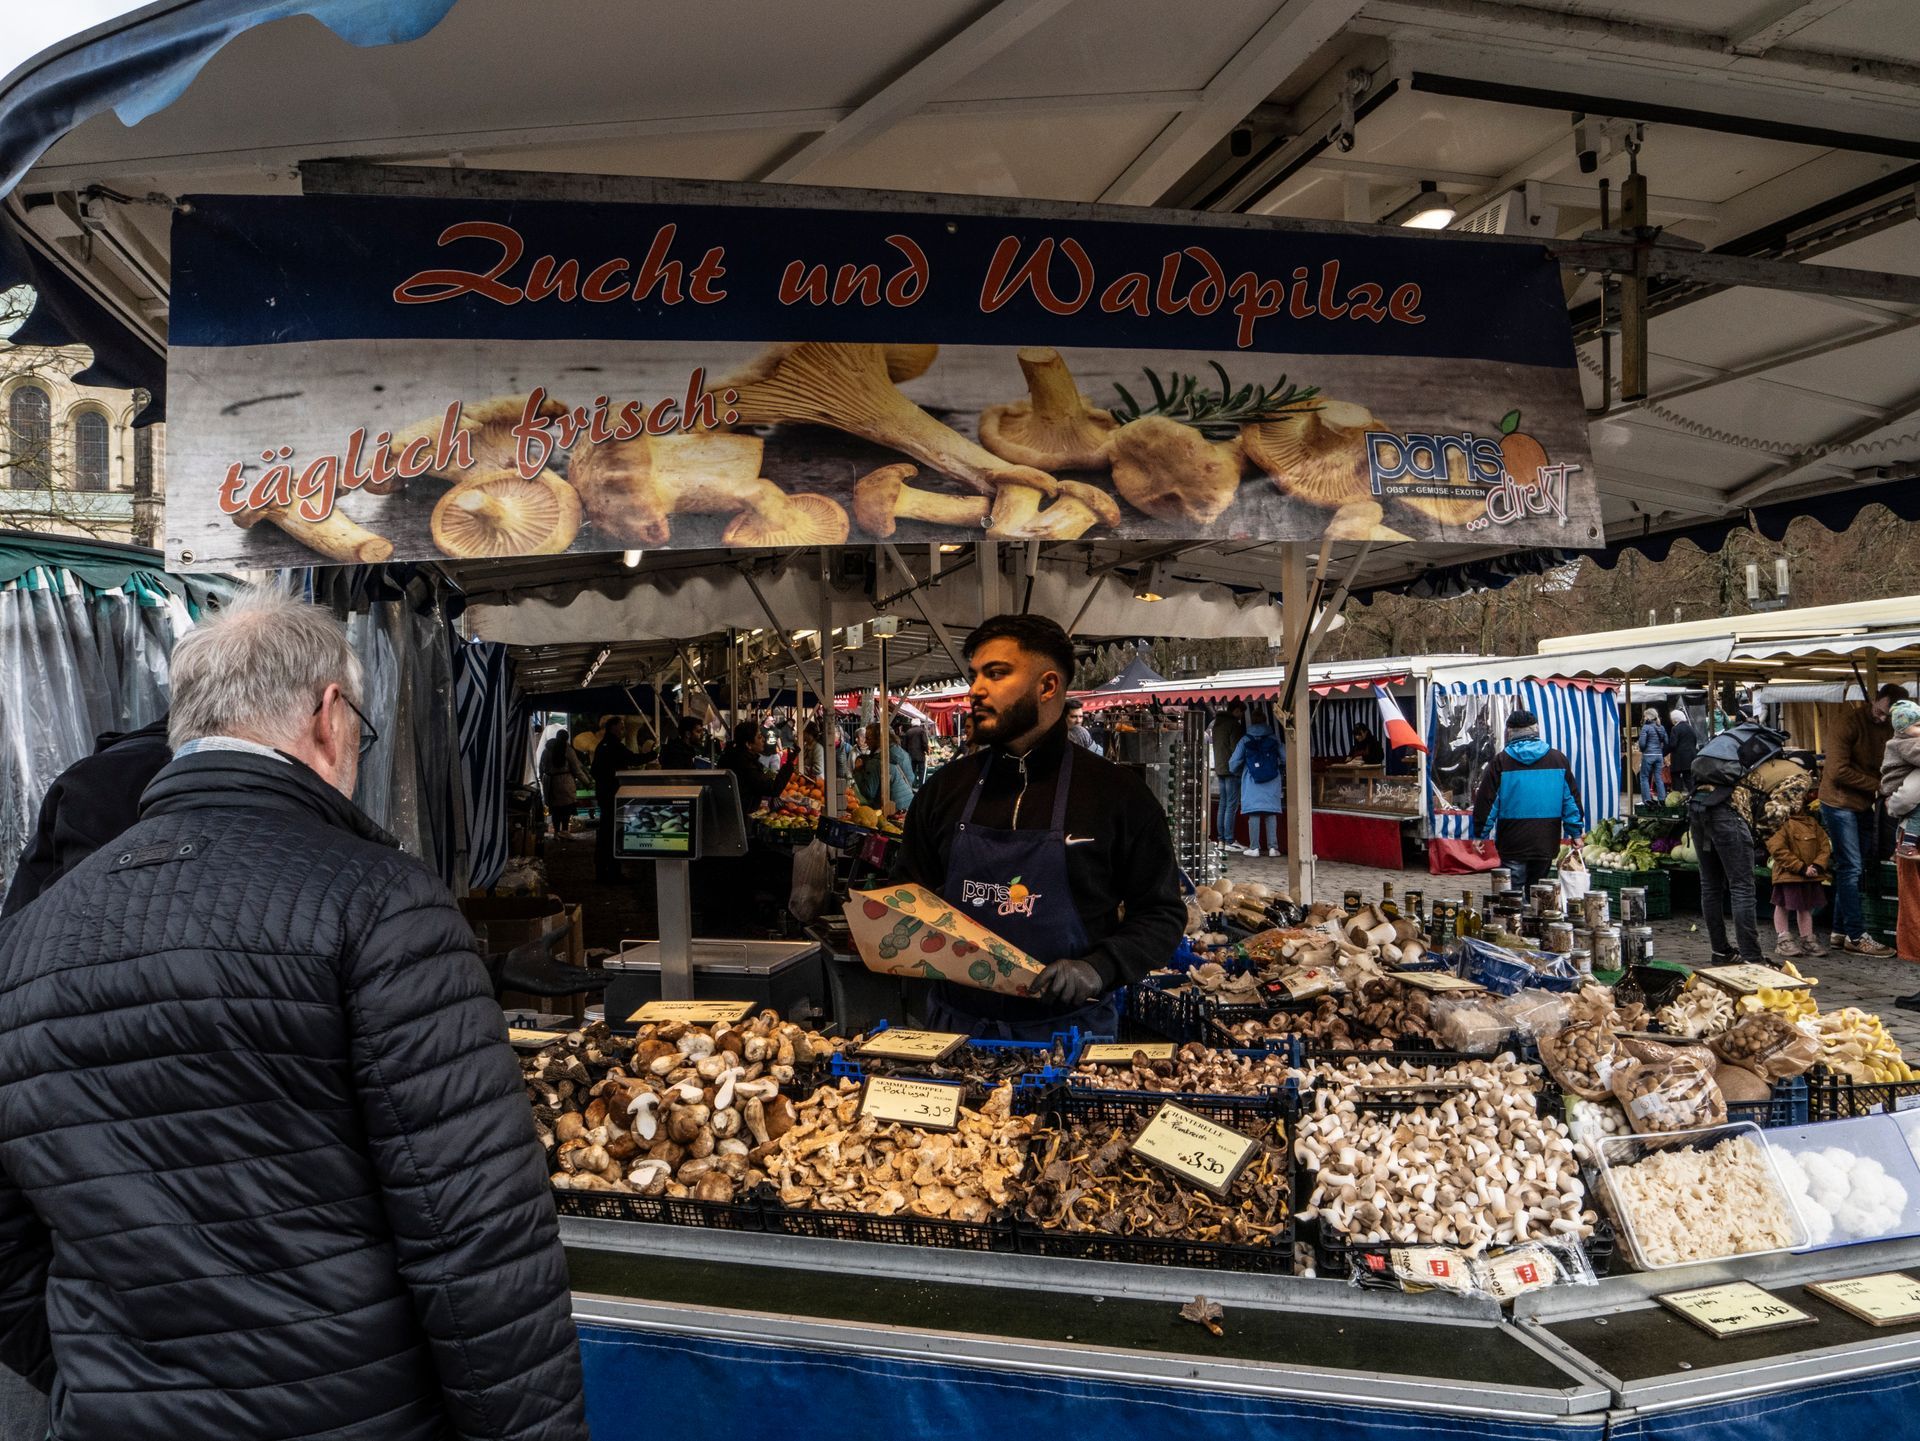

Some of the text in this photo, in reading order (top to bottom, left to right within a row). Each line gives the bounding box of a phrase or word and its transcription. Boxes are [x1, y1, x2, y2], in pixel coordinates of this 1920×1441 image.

[394, 221, 1426, 348] Zucht und Waldpilze
[216, 366, 740, 522] täglich frisch:
[1364, 431, 1506, 495] paris
[1386, 486, 1409, 494] OBST
[1455, 488, 1486, 497] EXOTEN
[876, 1080, 944, 1094] SEMMELSTOPPEL
[883, 1086, 930, 1098] Portugal
[1166, 1109, 1225, 1138] CHANTERELLE
[1489, 1267, 1506, 1296] ENOKI
